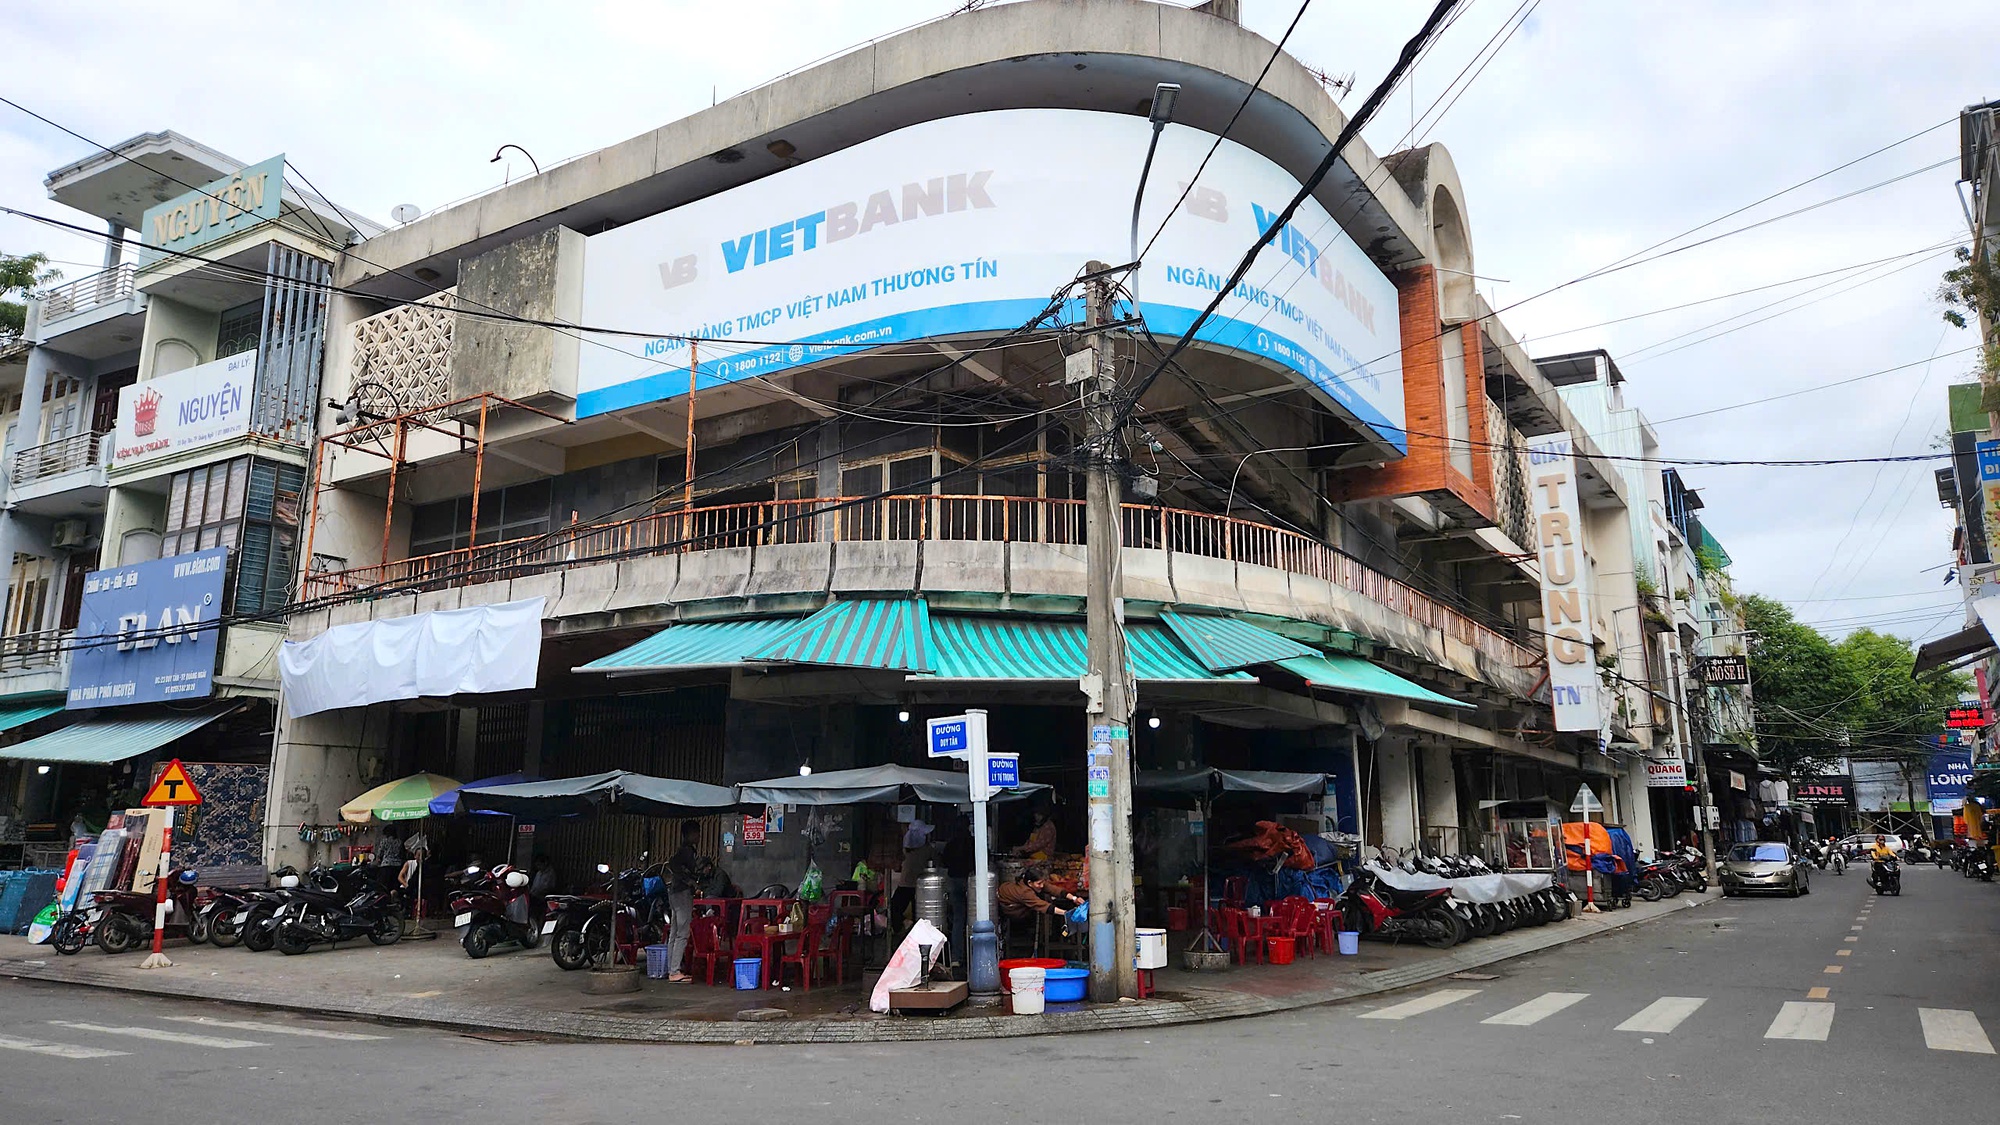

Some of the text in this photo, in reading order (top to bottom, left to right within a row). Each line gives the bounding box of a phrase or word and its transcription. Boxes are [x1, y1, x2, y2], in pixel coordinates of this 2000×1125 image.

[152, 171, 267, 247] NGUYỆN
[721, 169, 997, 274] VIETBANK
[658, 253, 699, 290] VB
[1251, 201, 1376, 337] VIETBANK
[644, 332, 686, 358] NGÂN
[737, 307, 782, 333] TMCP
[786, 295, 823, 319] VIỆT
[827, 283, 867, 310] NAM
[871, 265, 955, 298] THƯƠNG
[961, 256, 998, 281] TÍN
[1167, 265, 1220, 292] NGÂN
[1273, 295, 1304, 326] TMCP
[809, 326, 892, 354] vietbank.com.vn
[1273, 341, 1290, 357] 1800
[734, 352, 781, 372] 1800 1122
[178, 382, 242, 427] NGUYỆN
[1537, 473, 1586, 665] TRUNG
[117, 604, 202, 652] ELAN
[936, 724, 961, 735] ĐƯỜNG
[940, 736, 958, 747] DUY TÂN
[991, 771, 997, 781] LÝ
[992, 758, 1013, 768] ĐƯỜNG
[1648, 765, 1682, 774] QUANG
[1947, 761, 1968, 770] NHÀ
